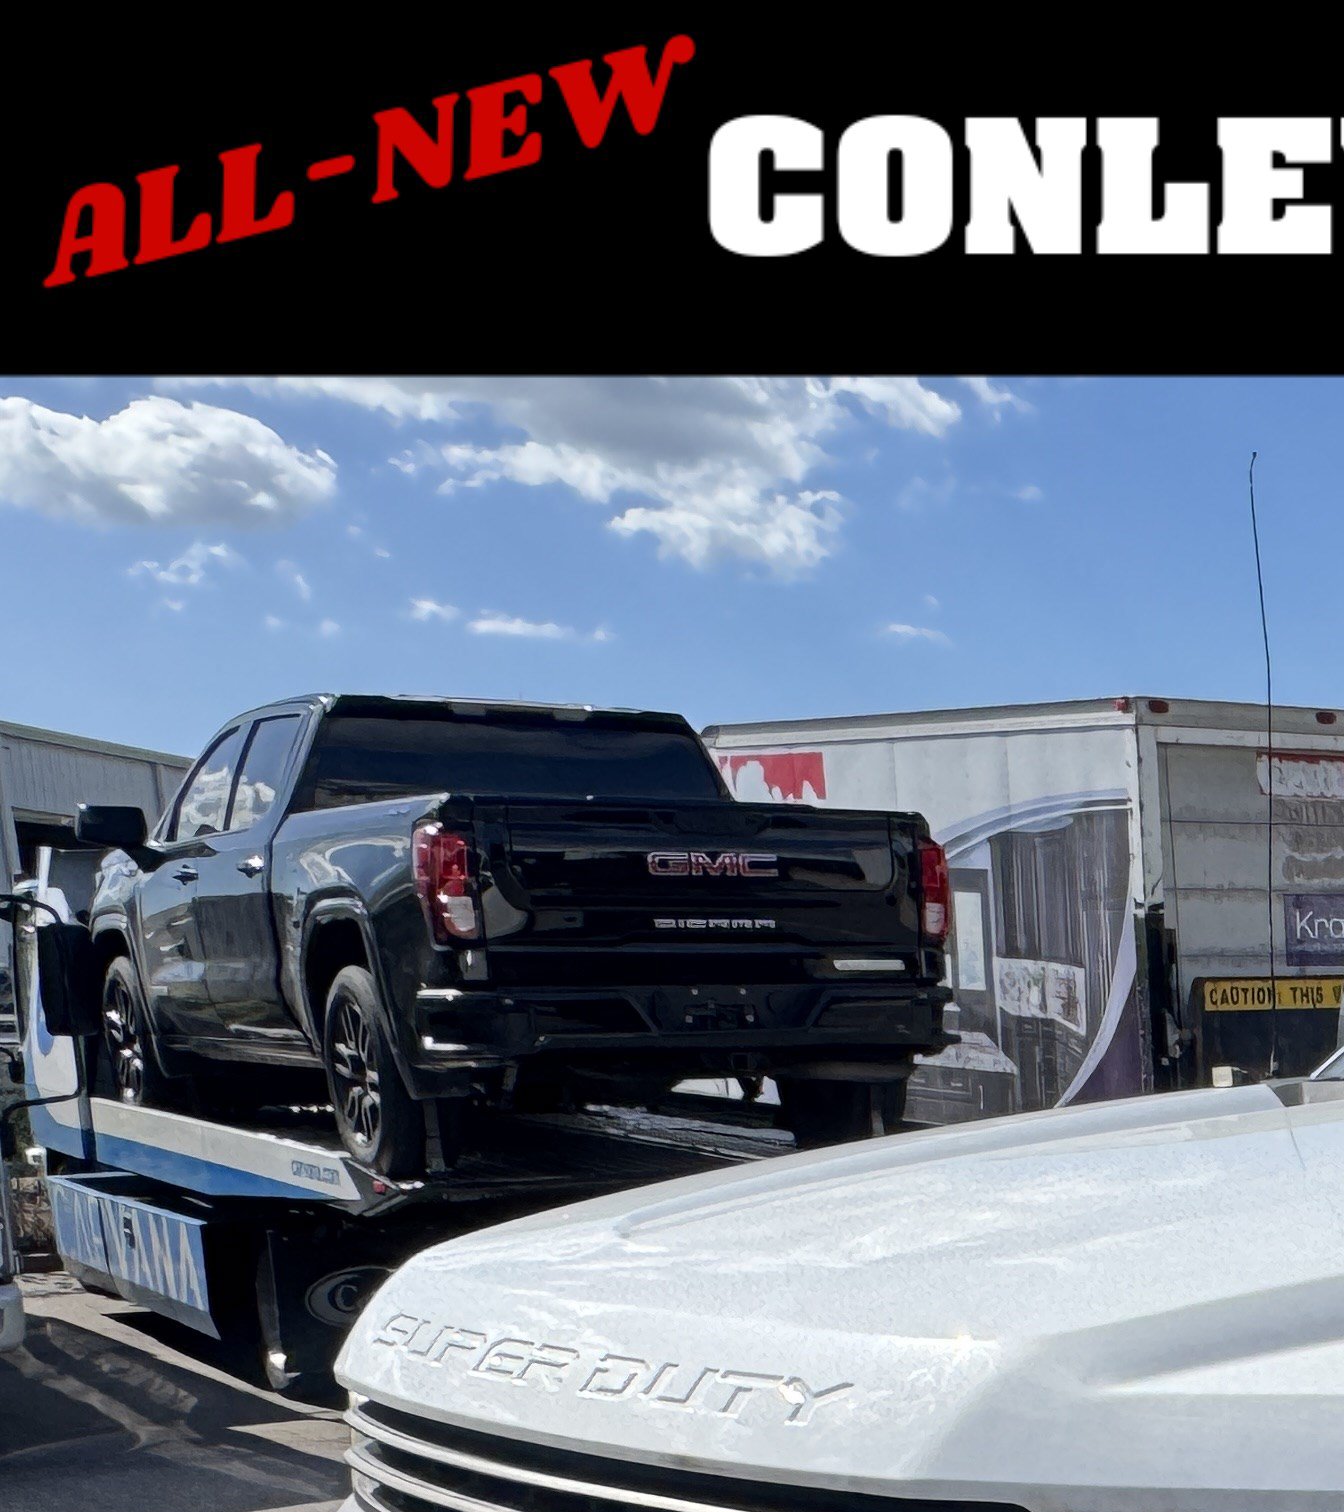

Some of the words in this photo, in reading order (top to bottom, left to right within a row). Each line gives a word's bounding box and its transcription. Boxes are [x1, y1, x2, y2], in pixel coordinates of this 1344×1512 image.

[647, 851, 779, 877] GMC
[1289, 986, 1324, 1005] THIS
[372, 1312, 580, 1391] SUPER
[576, 1353, 855, 1427] DUTY
